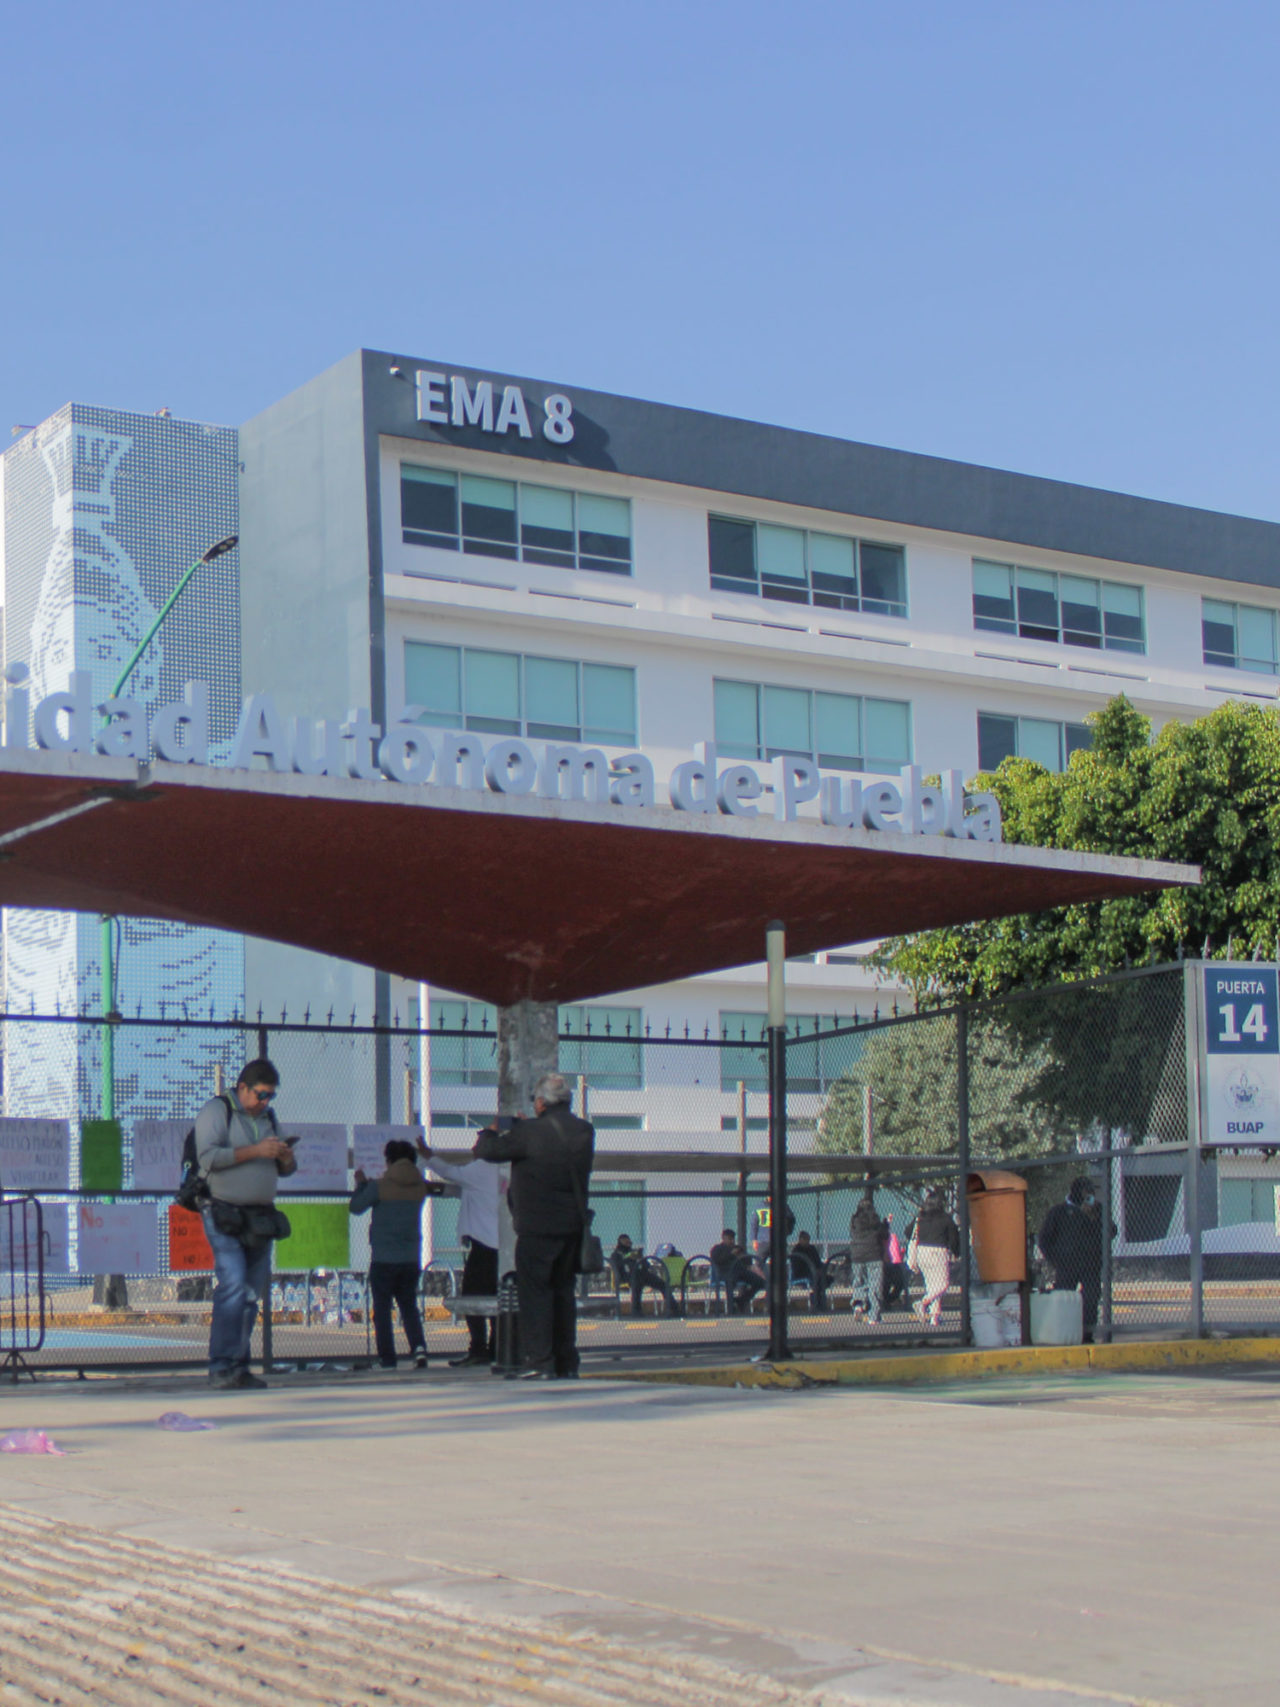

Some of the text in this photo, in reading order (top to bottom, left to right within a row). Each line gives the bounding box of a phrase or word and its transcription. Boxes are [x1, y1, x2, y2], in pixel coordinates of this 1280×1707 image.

[416, 370, 574, 445] EMA 8
[231, 689, 655, 807] Autónoma
[671, 741, 764, 818] de
[772, 755, 1003, 843] Puebla
[1216, 981, 1265, 994] PUERTA
[1219, 1003, 1268, 1042] 14
[1227, 1121, 1264, 1134] BUAP
